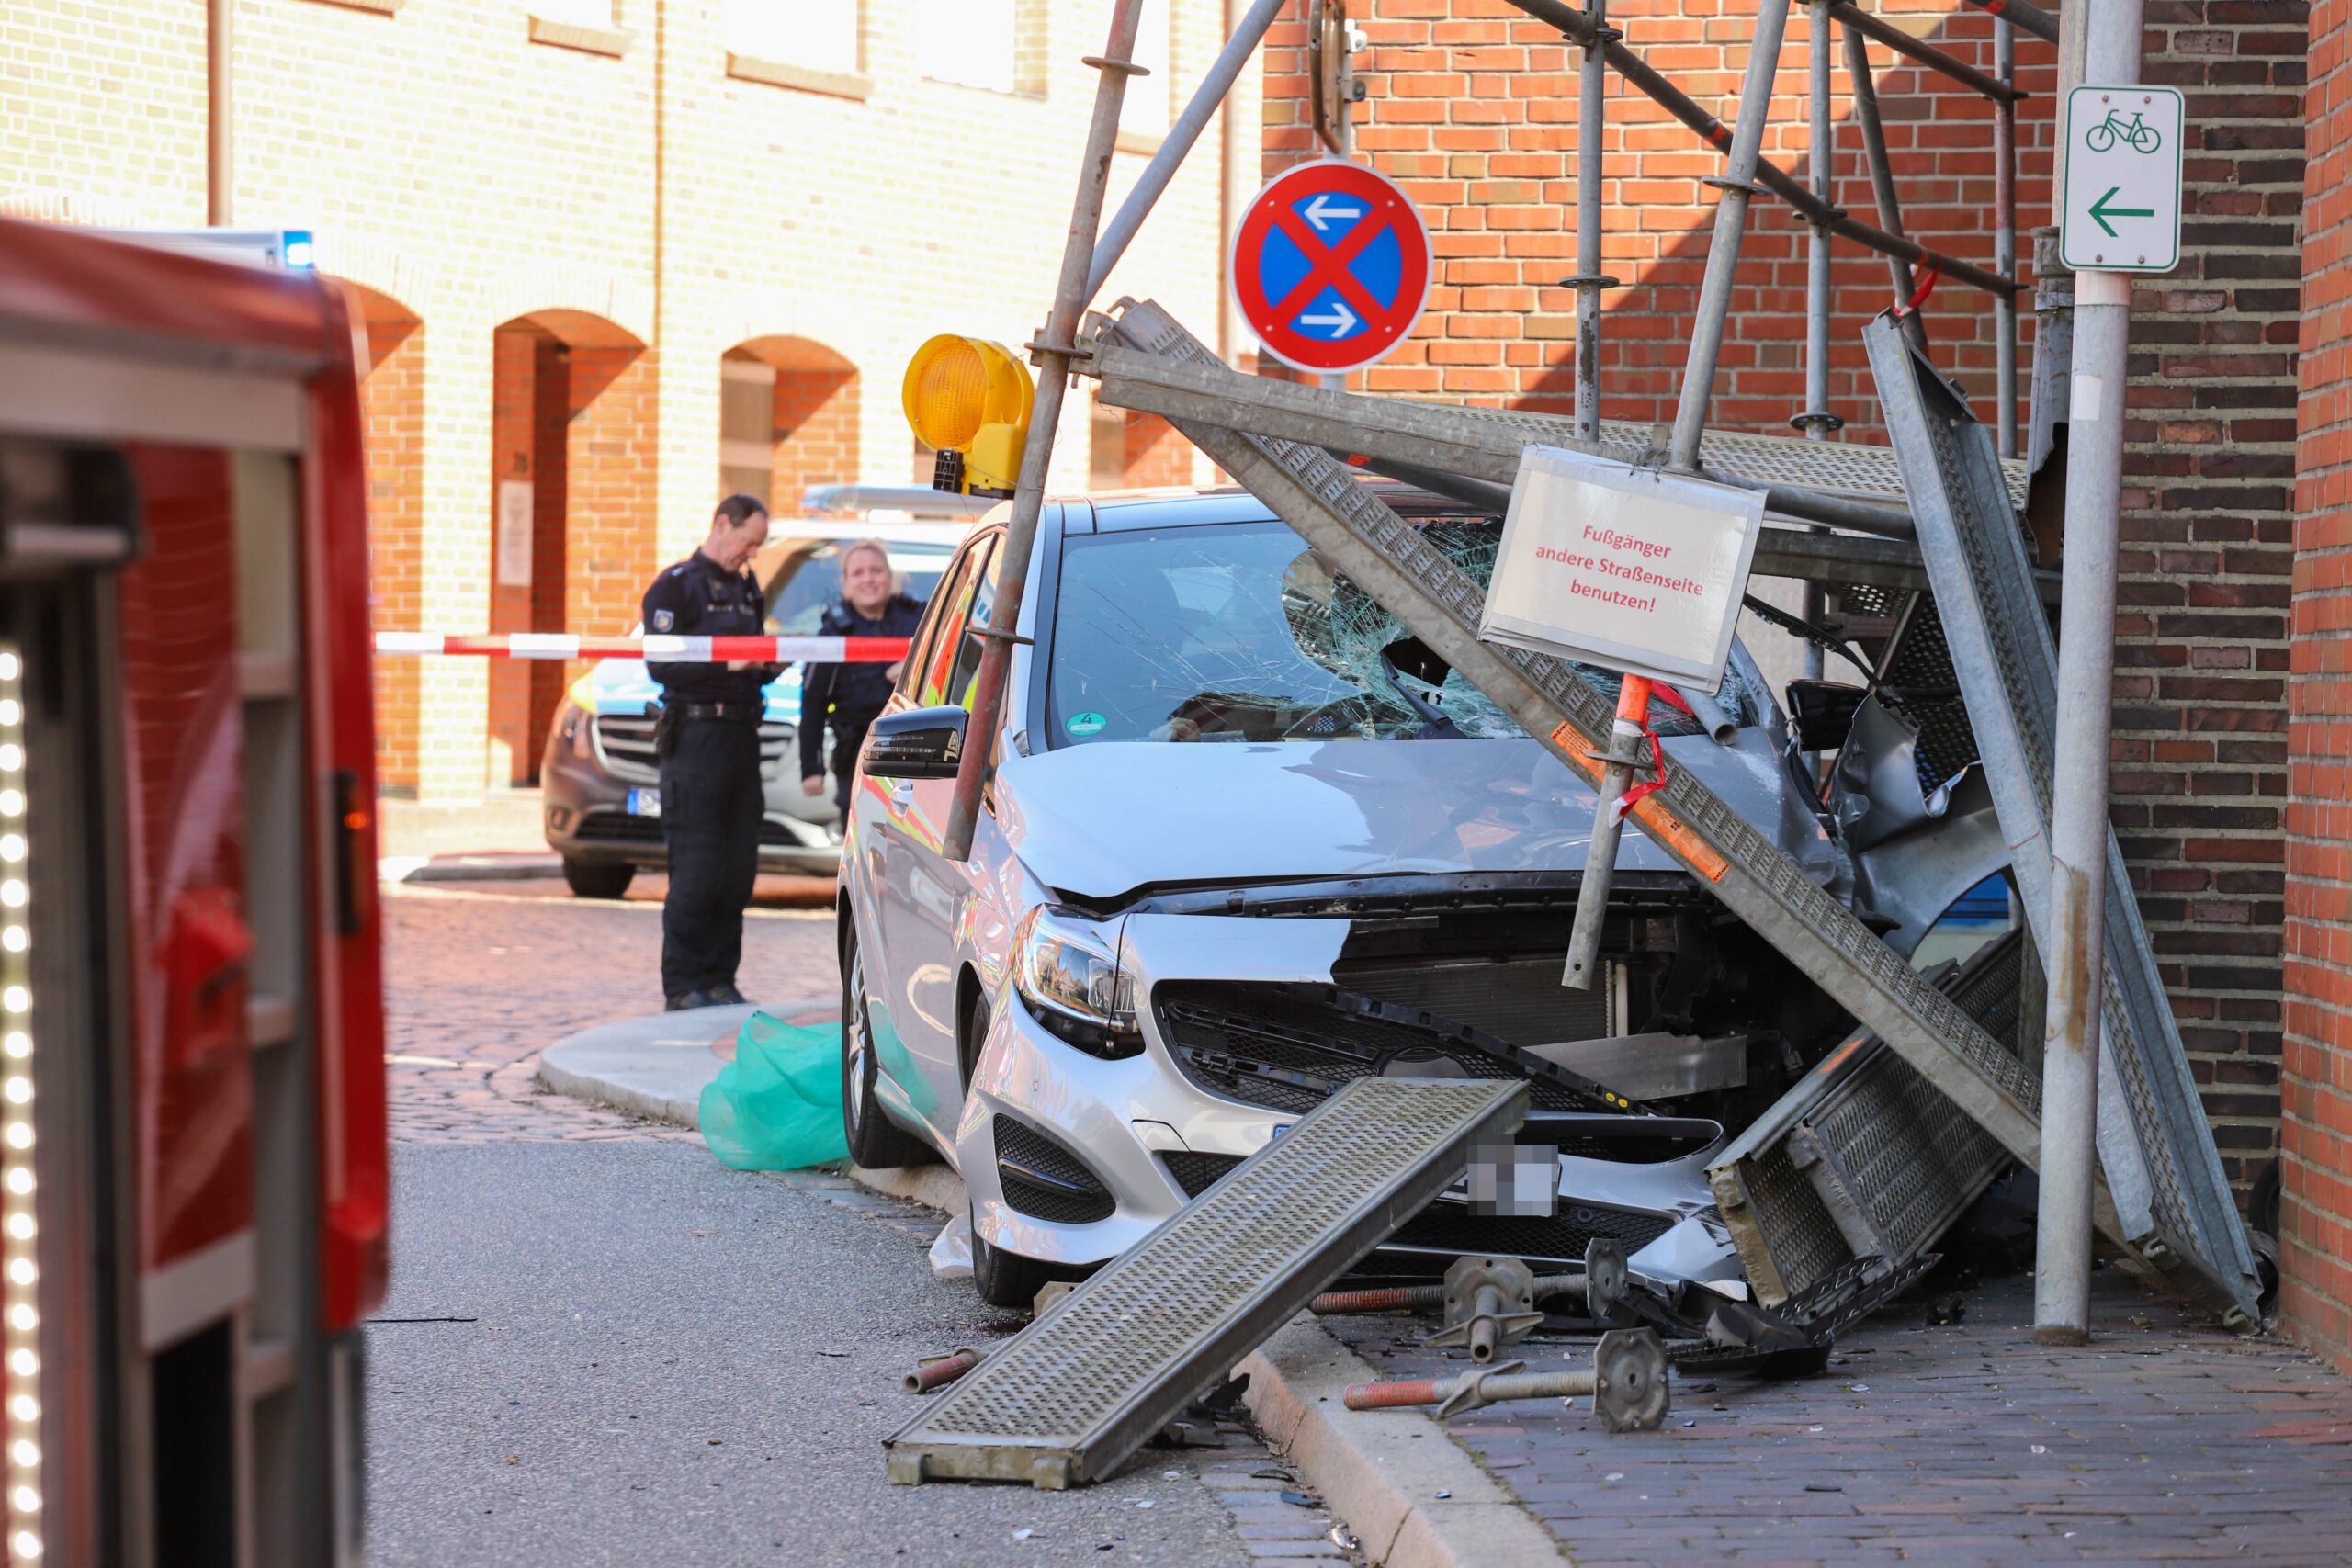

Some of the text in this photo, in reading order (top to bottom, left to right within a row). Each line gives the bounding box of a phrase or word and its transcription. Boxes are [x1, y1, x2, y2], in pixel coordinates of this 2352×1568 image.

[1582, 525, 1671, 558] Fußgänger
[1536, 546, 1703, 596] andere Straßenseite
[1570, 580, 1657, 613] benutzen!
[1080, 713, 1092, 724] 4
